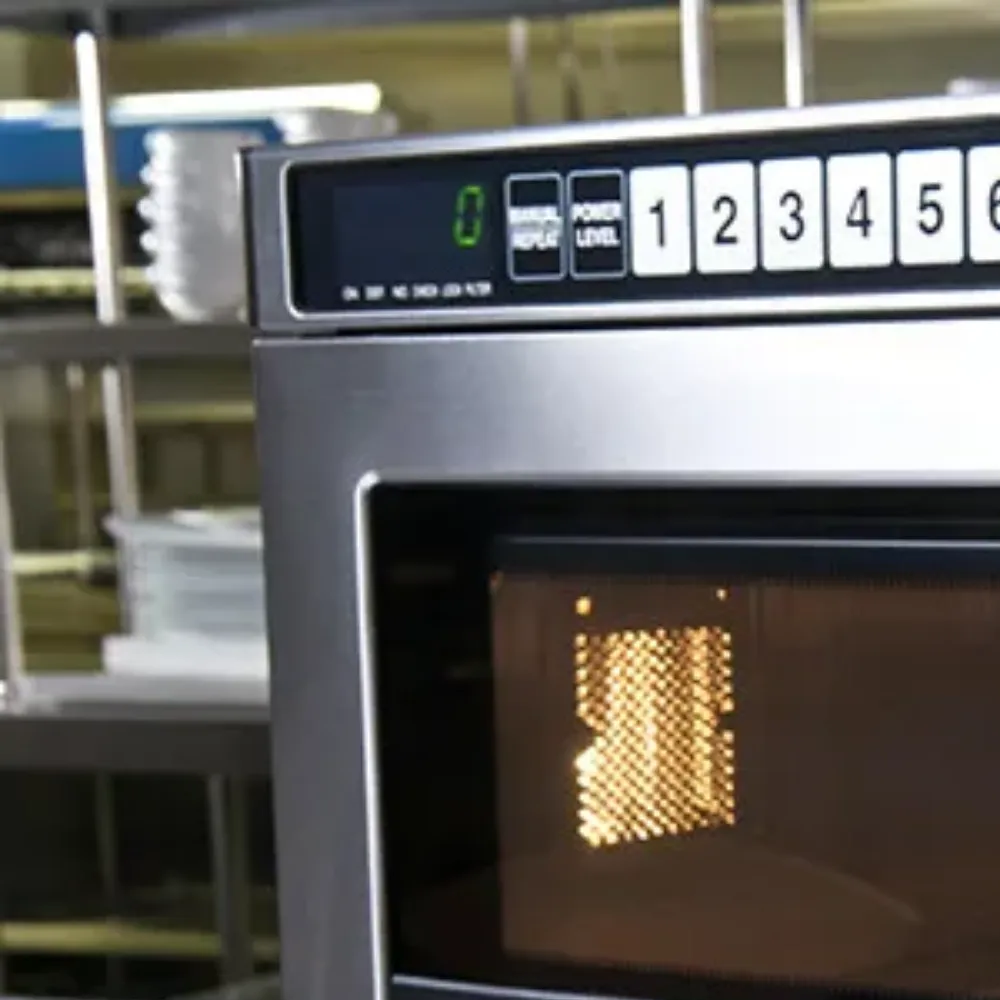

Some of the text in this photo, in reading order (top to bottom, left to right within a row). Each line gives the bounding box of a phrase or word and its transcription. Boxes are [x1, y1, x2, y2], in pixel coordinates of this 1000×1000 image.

[454, 185, 485, 246] 0
[576, 226, 620, 248] LEVEL
[651, 200, 664, 246] 1
[713, 196, 738, 244] 2
[780, 190, 805, 242] 3
[847, 187, 872, 238] 4
[918, 183, 943, 235] 5
